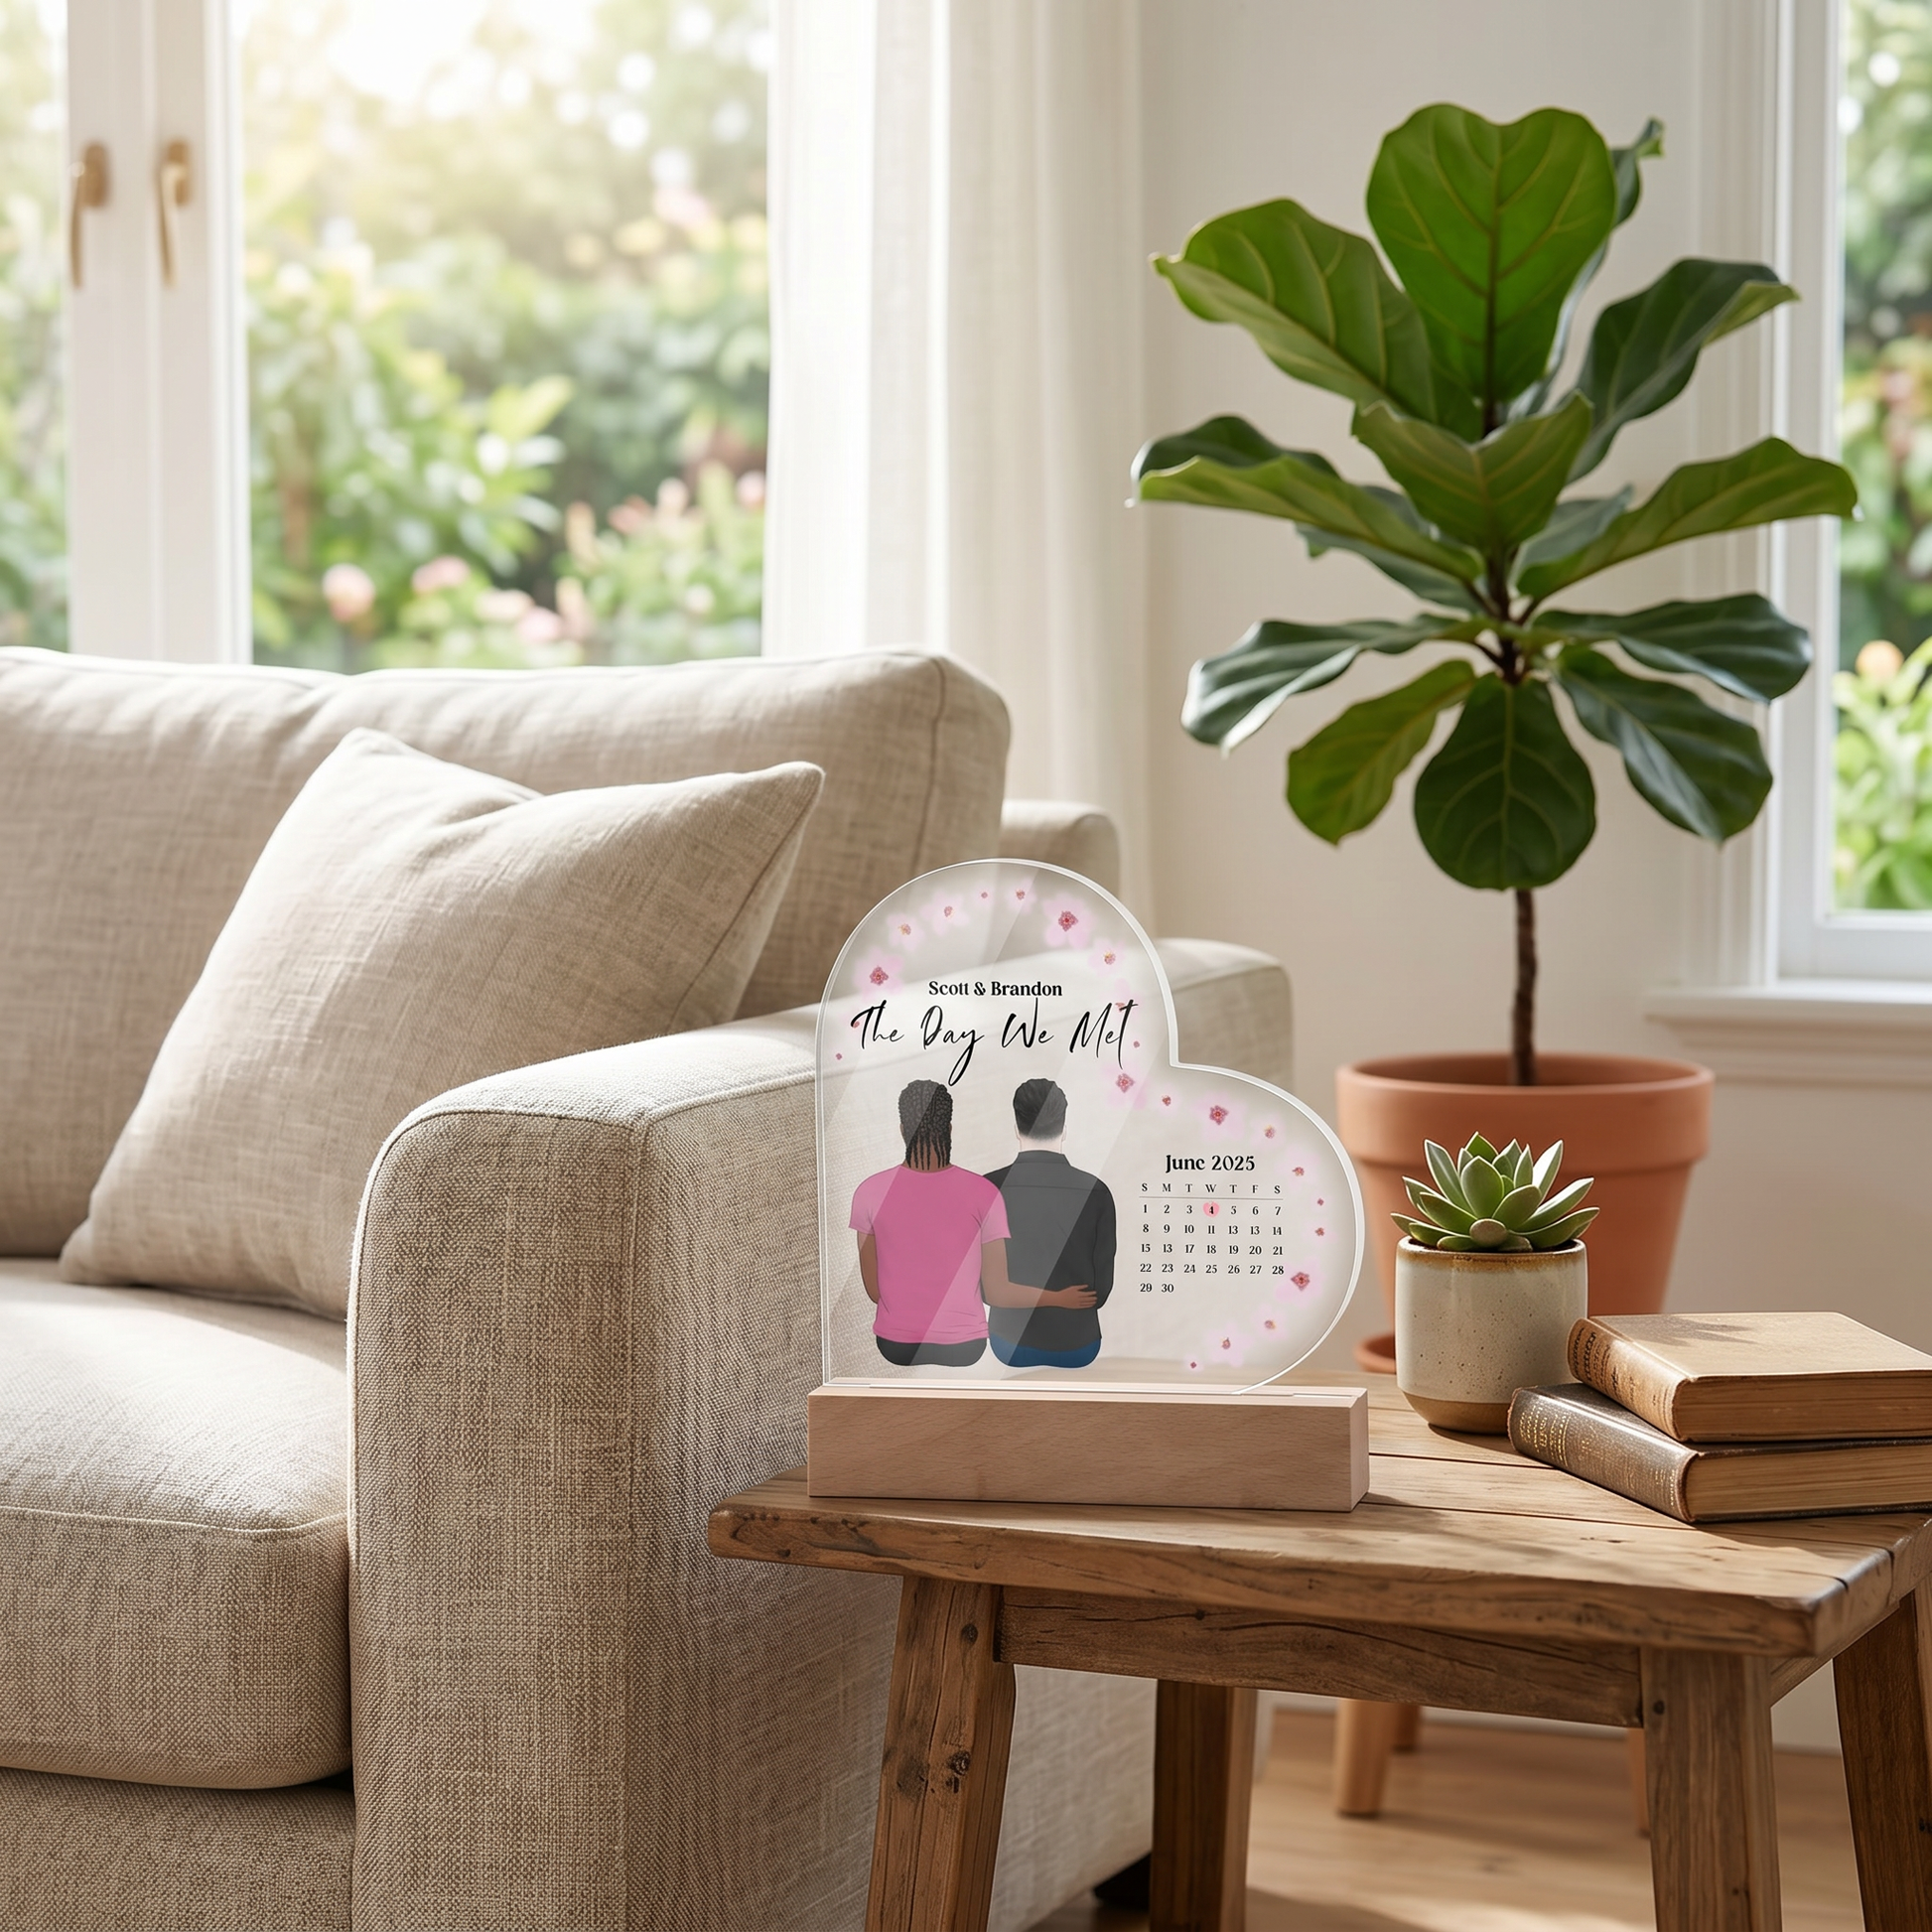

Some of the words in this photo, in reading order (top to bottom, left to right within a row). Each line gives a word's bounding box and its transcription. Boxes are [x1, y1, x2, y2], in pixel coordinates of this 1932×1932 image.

[928, 980, 969, 996] Scott
[973, 981, 986, 996] &
[991, 981, 1062, 997] Brandon
[850, 999, 903, 1049] The
[920, 1005, 985, 1086] Day
[1001, 997, 1054, 1048] We
[1069, 999, 1139, 1069] Met
[1165, 1154, 1206, 1173] June
[1211, 1155, 1256, 1172] 2025
[1141, 1182, 1149, 1192] S
[1162, 1182, 1173, 1193] M
[1184, 1183, 1194, 1193] T
[1204, 1183, 1217, 1193] W
[1229, 1184, 1238, 1194] T
[1252, 1184, 1259, 1194] F
[1274, 1184, 1282, 1195] S
[1143, 1203, 1149, 1214] 1
[1163, 1203, 1172, 1214] 2
[1185, 1204, 1193, 1215] 3
[1207, 1204, 1215, 1216] 4
[1230, 1205, 1238, 1216] 5
[1252, 1205, 1260, 1216] 6
[1274, 1205, 1282, 1216] 7
[1142, 1223, 1150, 1234] 8
[1163, 1223, 1172, 1235] 9
[1183, 1224, 1195, 1235] 10
[1207, 1224, 1216, 1235] 11
[1250, 1225, 1261, 1236] 13
[1272, 1226, 1283, 1237] 14
[1141, 1243, 1152, 1254] 15
[1184, 1243, 1195, 1254] 17
[1206, 1244, 1217, 1255] 18
[1228, 1244, 1240, 1255] 19
[1248, 1245, 1263, 1256] 20
[1272, 1245, 1284, 1257] 21
[1139, 1263, 1153, 1274] 22
[1161, 1263, 1174, 1274] 23
[1183, 1263, 1196, 1274] 24
[1205, 1264, 1218, 1275] 25
[1227, 1264, 1241, 1275] 26
[1249, 1264, 1263, 1276] 27
[1272, 1265, 1285, 1276] 28
[1161, 1283, 1174, 1294] 30
